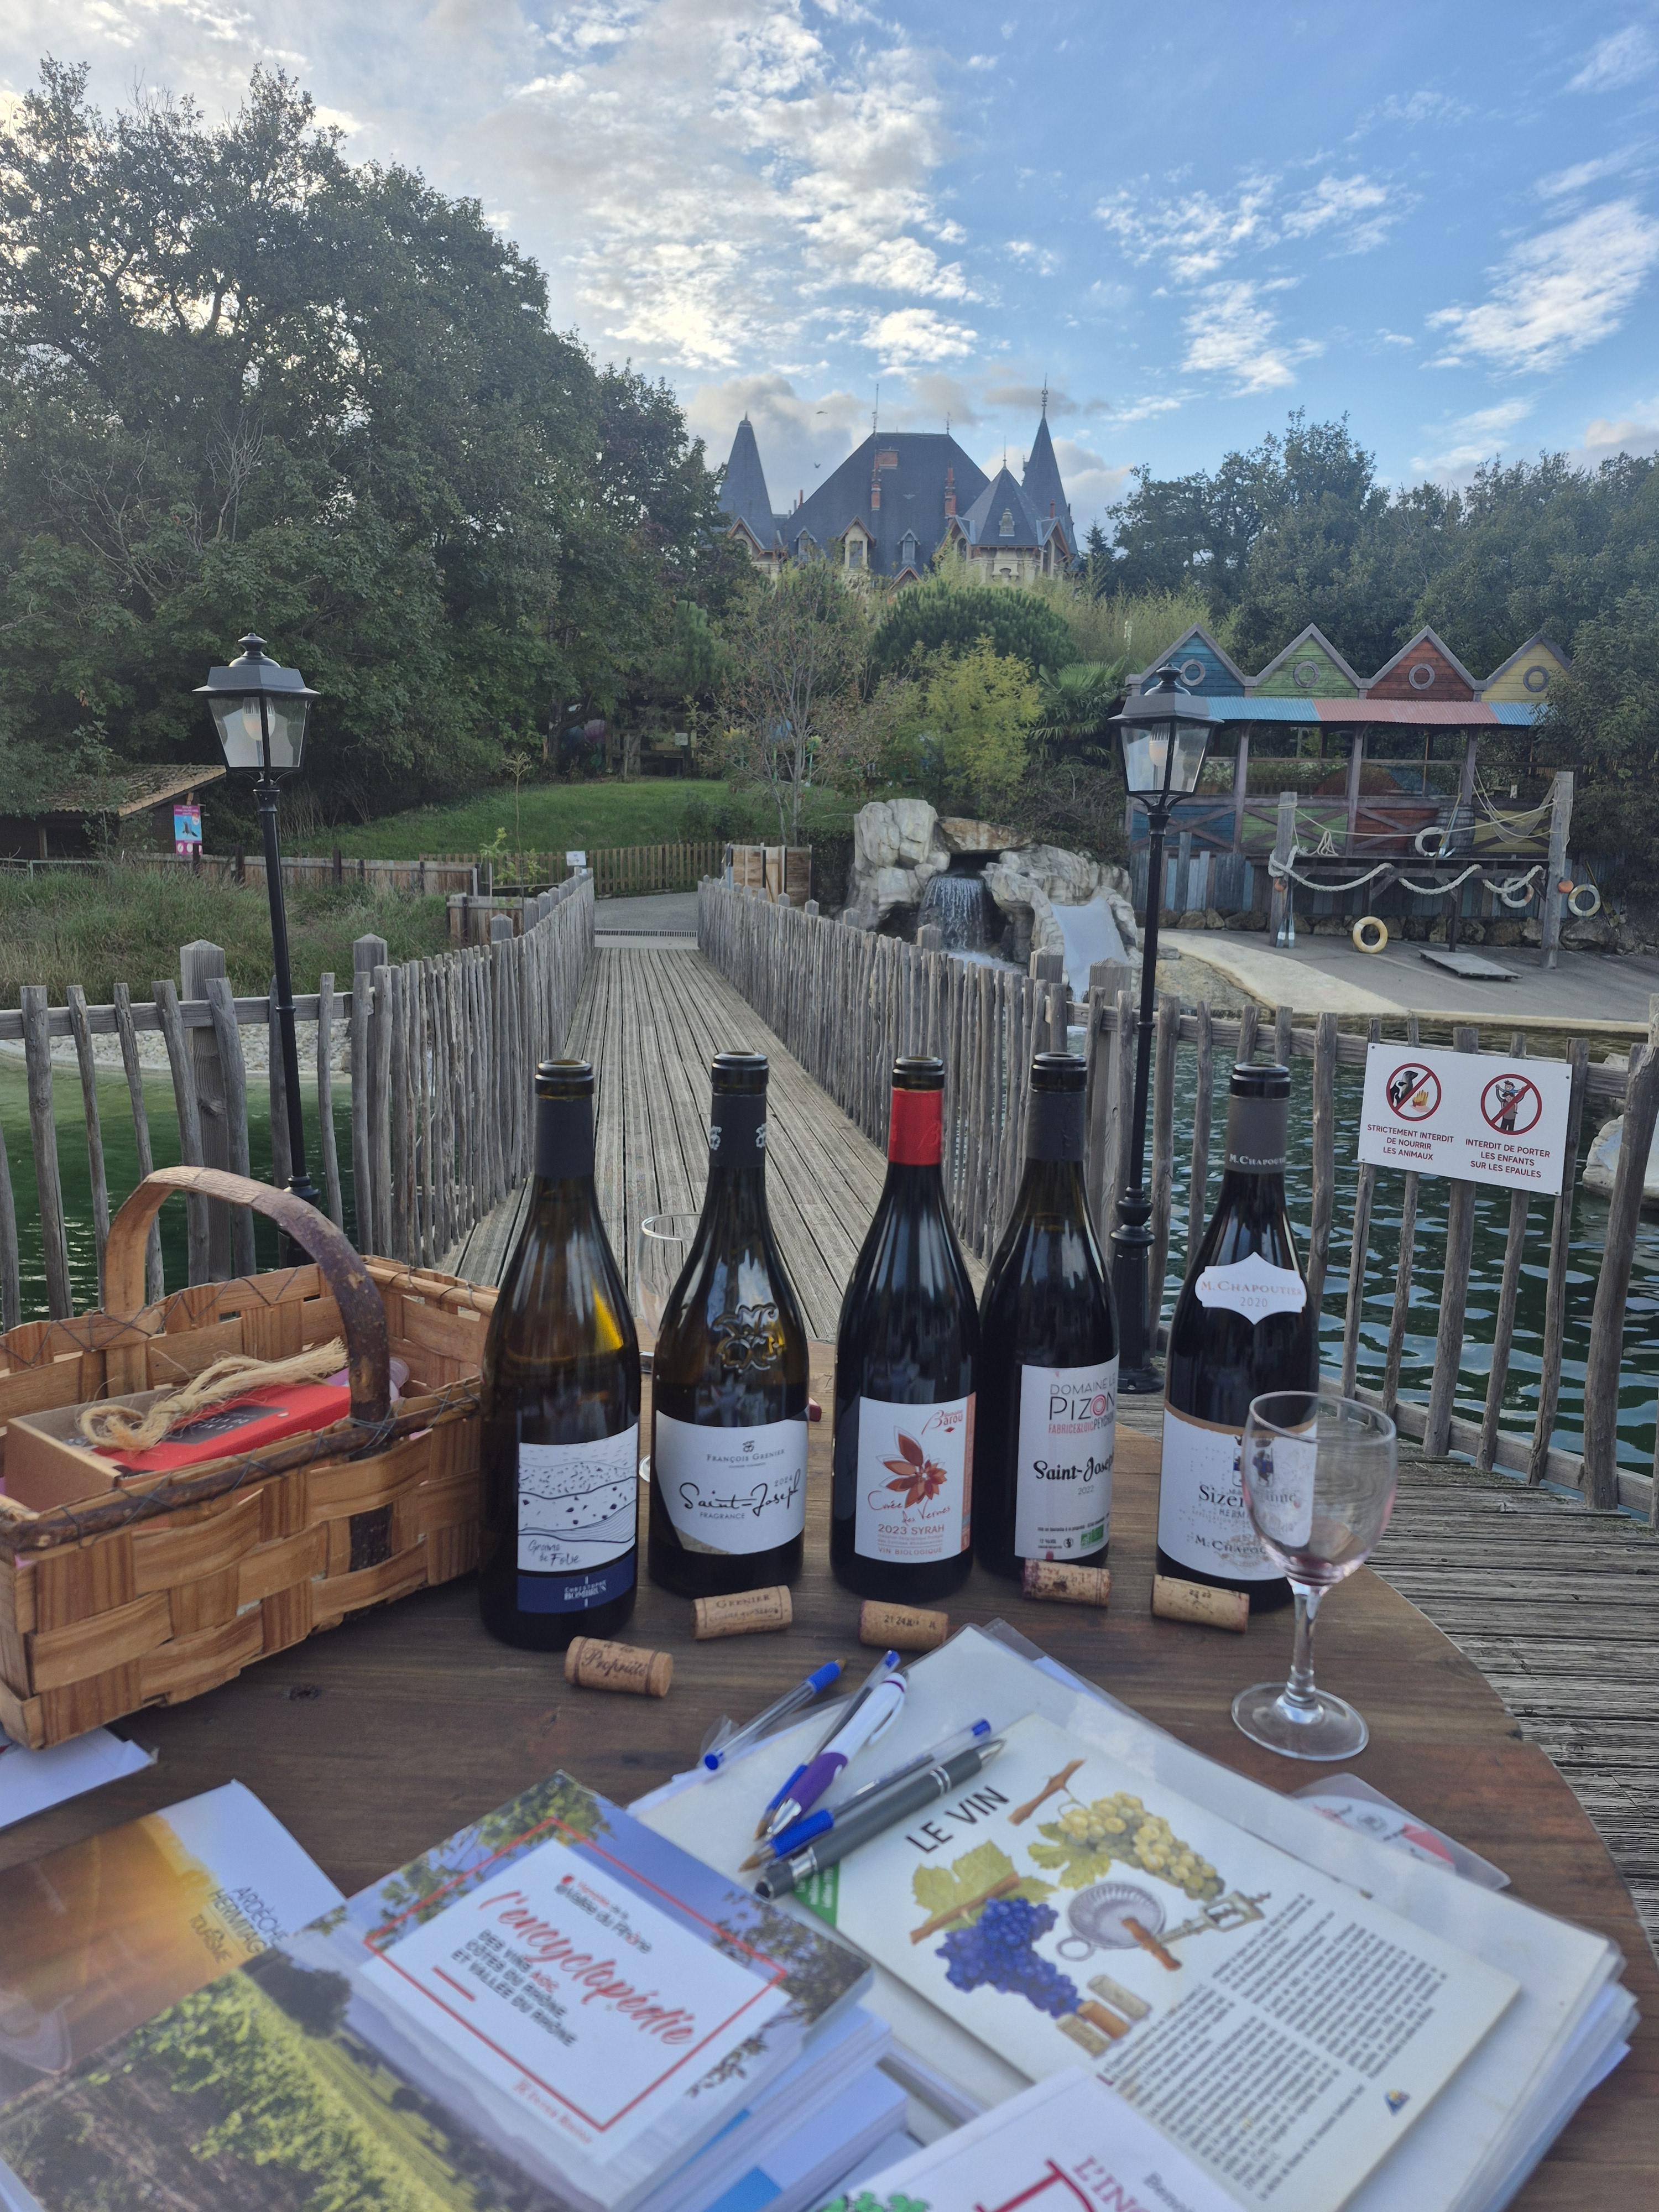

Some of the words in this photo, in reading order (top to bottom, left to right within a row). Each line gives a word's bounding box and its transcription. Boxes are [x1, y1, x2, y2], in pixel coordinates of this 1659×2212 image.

[1368, 1124, 1417, 1138] STRICTEMENT
[1420, 1131, 1454, 1143] INTERDIT
[1386, 1137, 1397, 1145] DE
[1399, 1139, 1432, 1150] NOURRIR
[1465, 1138, 1503, 1151] INTERDIT
[1504, 1144, 1515, 1152] DE
[1517, 1146, 1551, 1158] PORTER
[1383, 1146, 1397, 1155] LES
[1398, 1148, 1433, 1161] ANIMAUX
[1481, 1151, 1495, 1160] LES
[1498, 1154, 1535, 1166] ENFANTS
[1470, 1160, 1486, 1169] SUR
[1489, 1163, 1504, 1172] LES
[1505, 1166, 1541, 1178] EPAULES
[1218, 1281, 1301, 1295] CHAPOUTIER
[1240, 1297, 1268, 1307] 2020
[1050, 1378, 1107, 1395] DOMAINE
[1049, 1387, 1115, 1421] PIZON
[706, 1453, 749, 1463] FRANÇOIS
[753, 1449, 785, 1460] GRENIER
[1033, 1453, 1114, 1483] Saint-Josep
[868, 1490, 902, 1511] Cuvée
[878, 1524, 907, 1535] 2023
[911, 1524, 945, 1535] SYRAH
[878, 1546, 891, 1554] VIN
[895, 1546, 942, 1556] BIOLOGIQUE
[905, 1820, 953, 1853] LE
[944, 1785, 1009, 1824] VIN
[207, 1887, 268, 1954] HERMITAG
